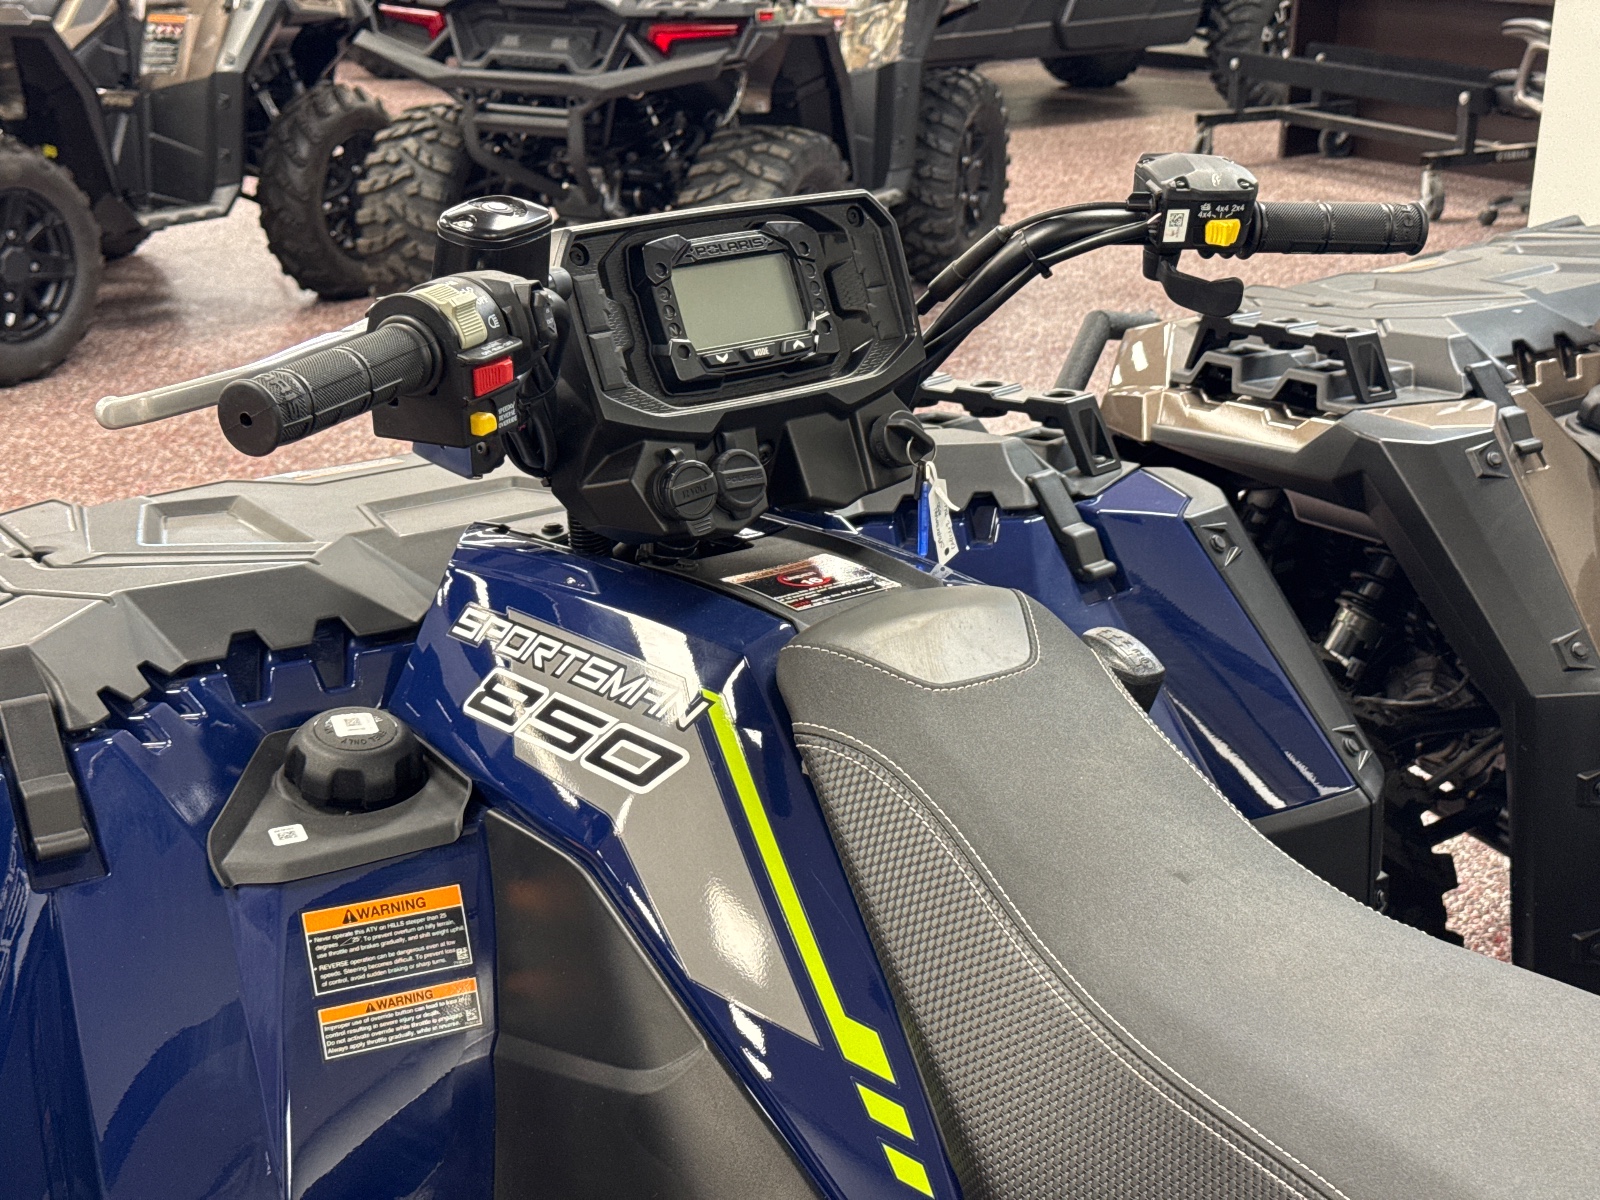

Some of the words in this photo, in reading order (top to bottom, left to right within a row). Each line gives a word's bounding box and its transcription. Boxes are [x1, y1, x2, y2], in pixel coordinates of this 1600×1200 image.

[1231, 204, 1245, 212] 2x4
[695, 237, 763, 255] POLARIS
[753, 346, 770, 357] MODE
[449, 605, 714, 731] SPORTSMAN
[463, 666, 690, 794] 850
[356, 896, 426, 919] WARNING
[371, 931, 392, 941] prevent
[318, 960, 348, 971] REVERSE
[376, 989, 433, 1010] WARNING
